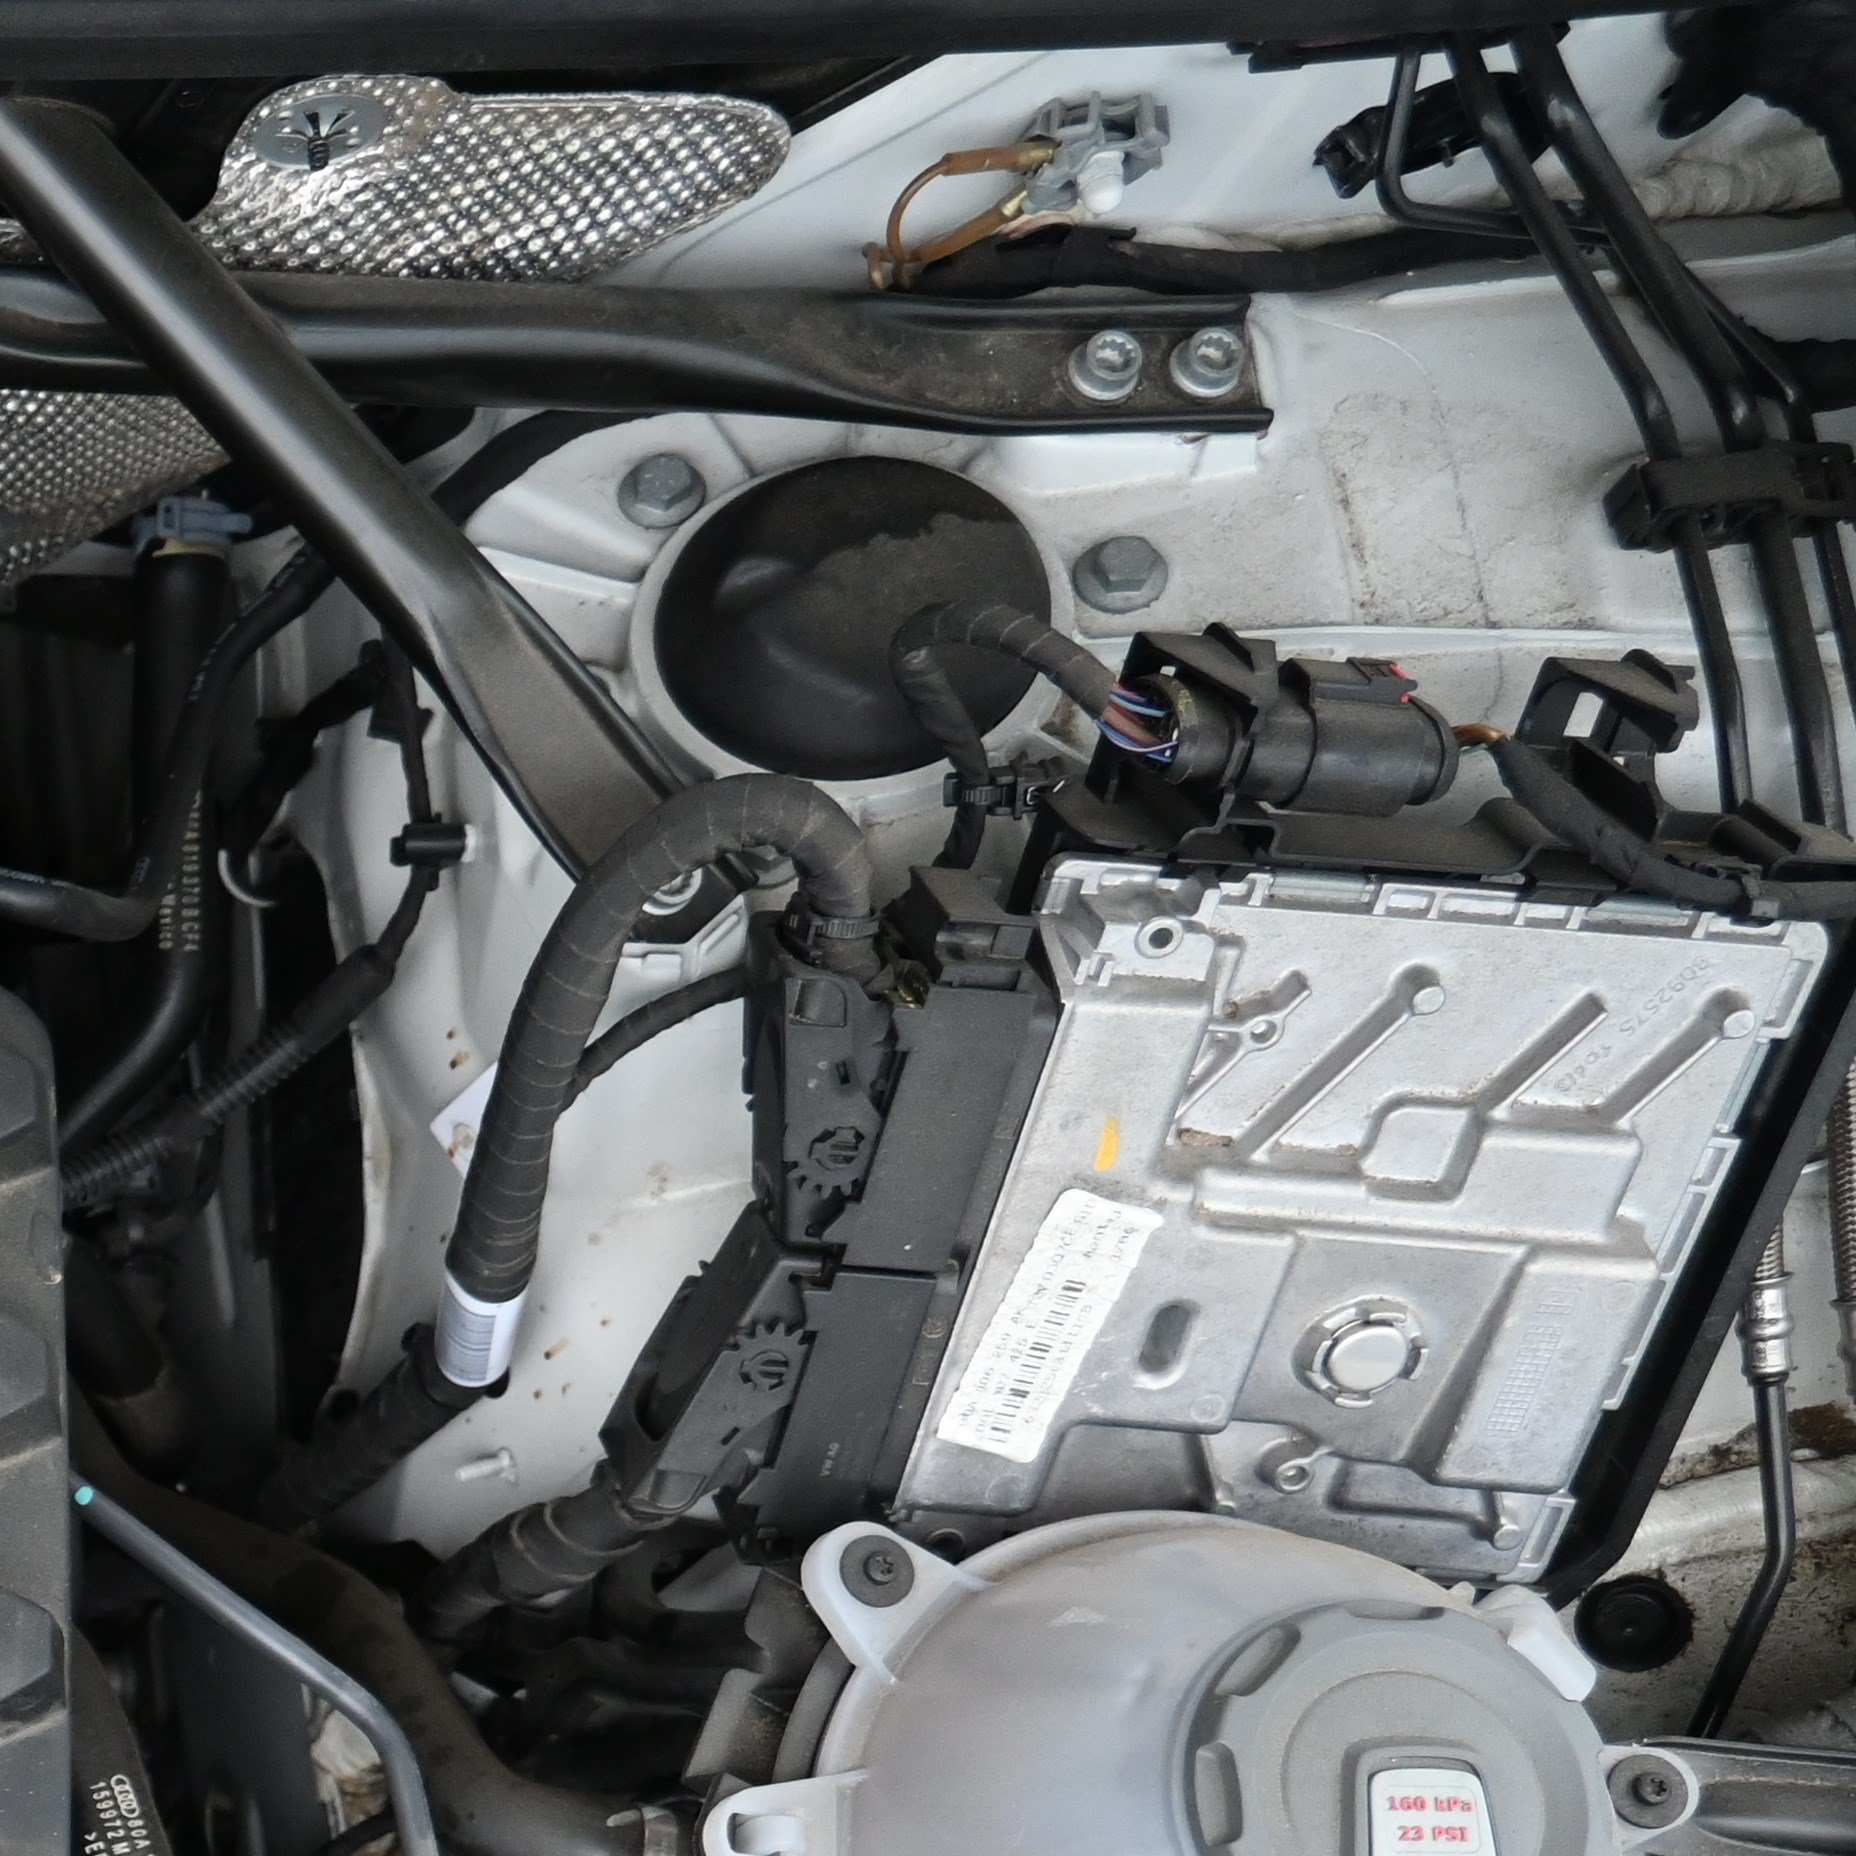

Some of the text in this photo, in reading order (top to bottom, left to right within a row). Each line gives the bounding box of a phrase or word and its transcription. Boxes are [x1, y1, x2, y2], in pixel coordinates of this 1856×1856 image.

[90, 1781, 125, 1839] 159972
[1387, 1796, 1473, 1812] 160 kPa
[1397, 1825, 1469, 1842] 23 PSI
